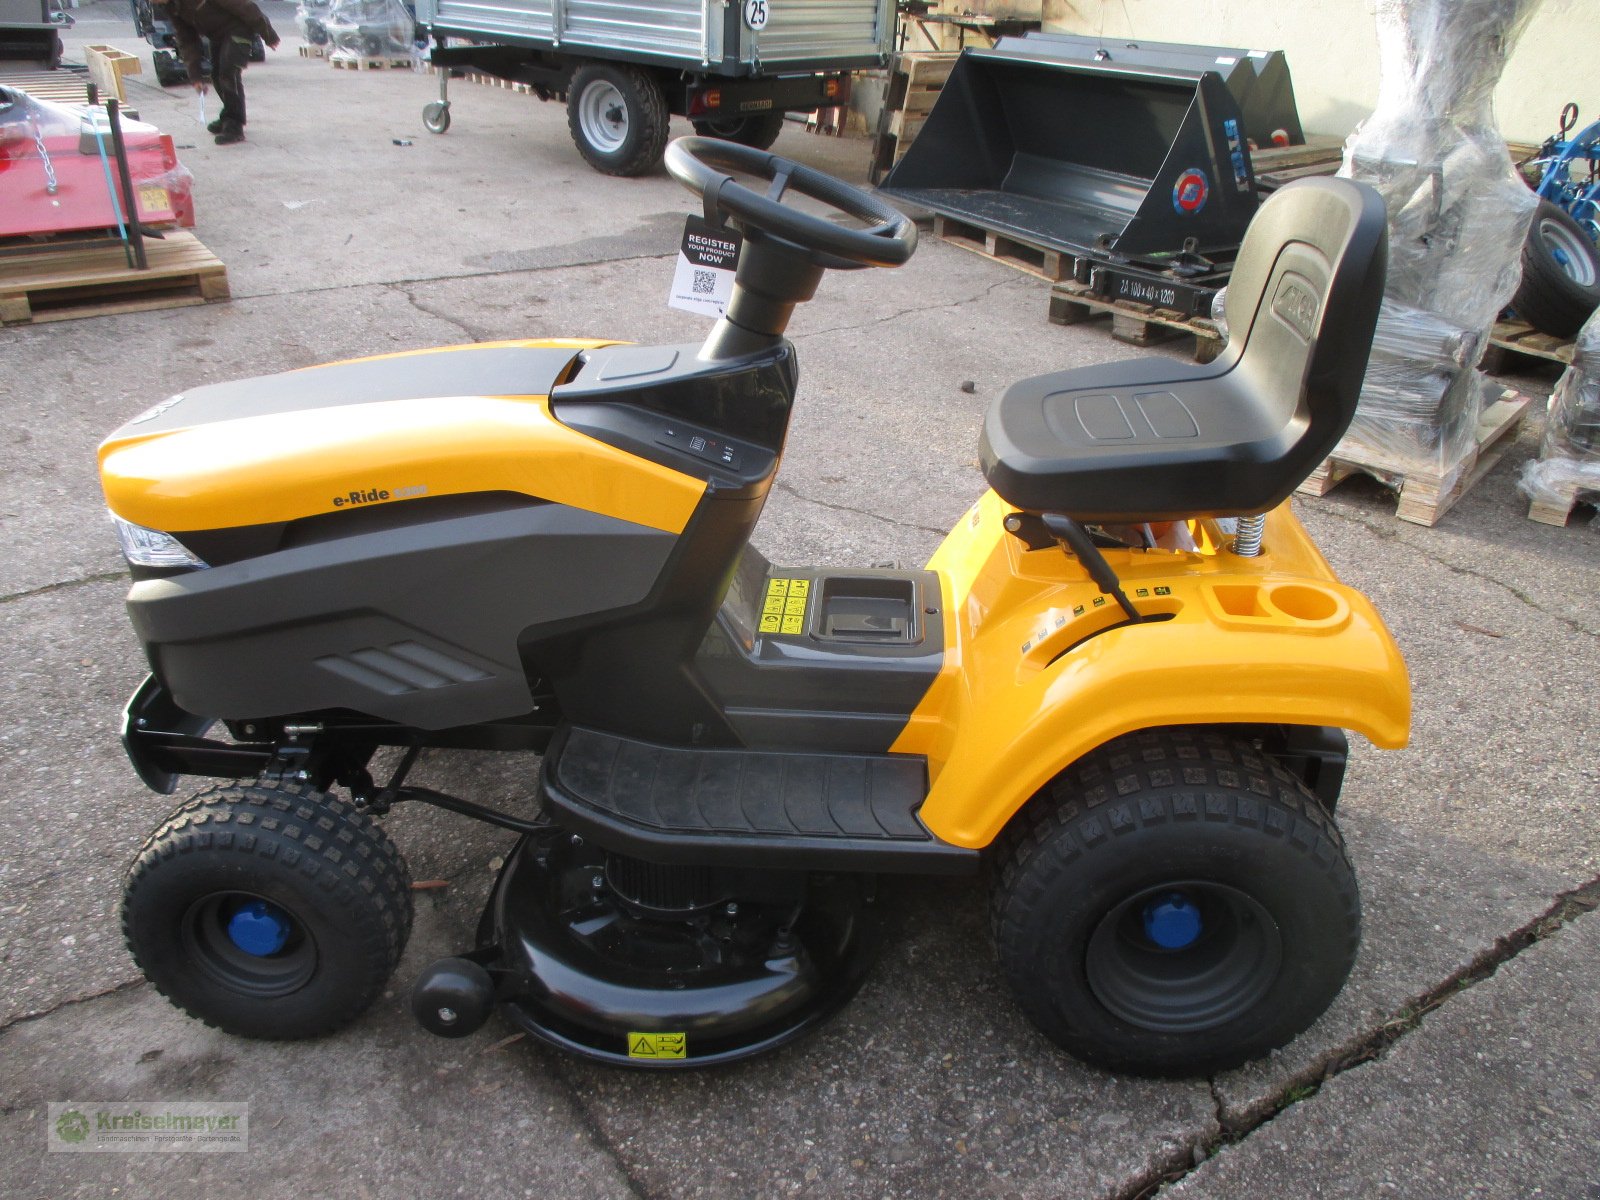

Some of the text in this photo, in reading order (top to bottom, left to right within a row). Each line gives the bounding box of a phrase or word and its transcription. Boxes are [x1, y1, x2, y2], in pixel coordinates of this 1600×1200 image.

[751, 1, 765, 24] 25
[688, 234, 736, 252] REGISTER
[688, 243, 736, 258] YOUR PRODUCT
[699, 252, 723, 264] NOW
[1130, 282, 1141, 298] 100
[1146, 285, 1154, 301] 40
[1160, 288, 1175, 305] 1200
[333, 488, 390, 507] e-Ride
